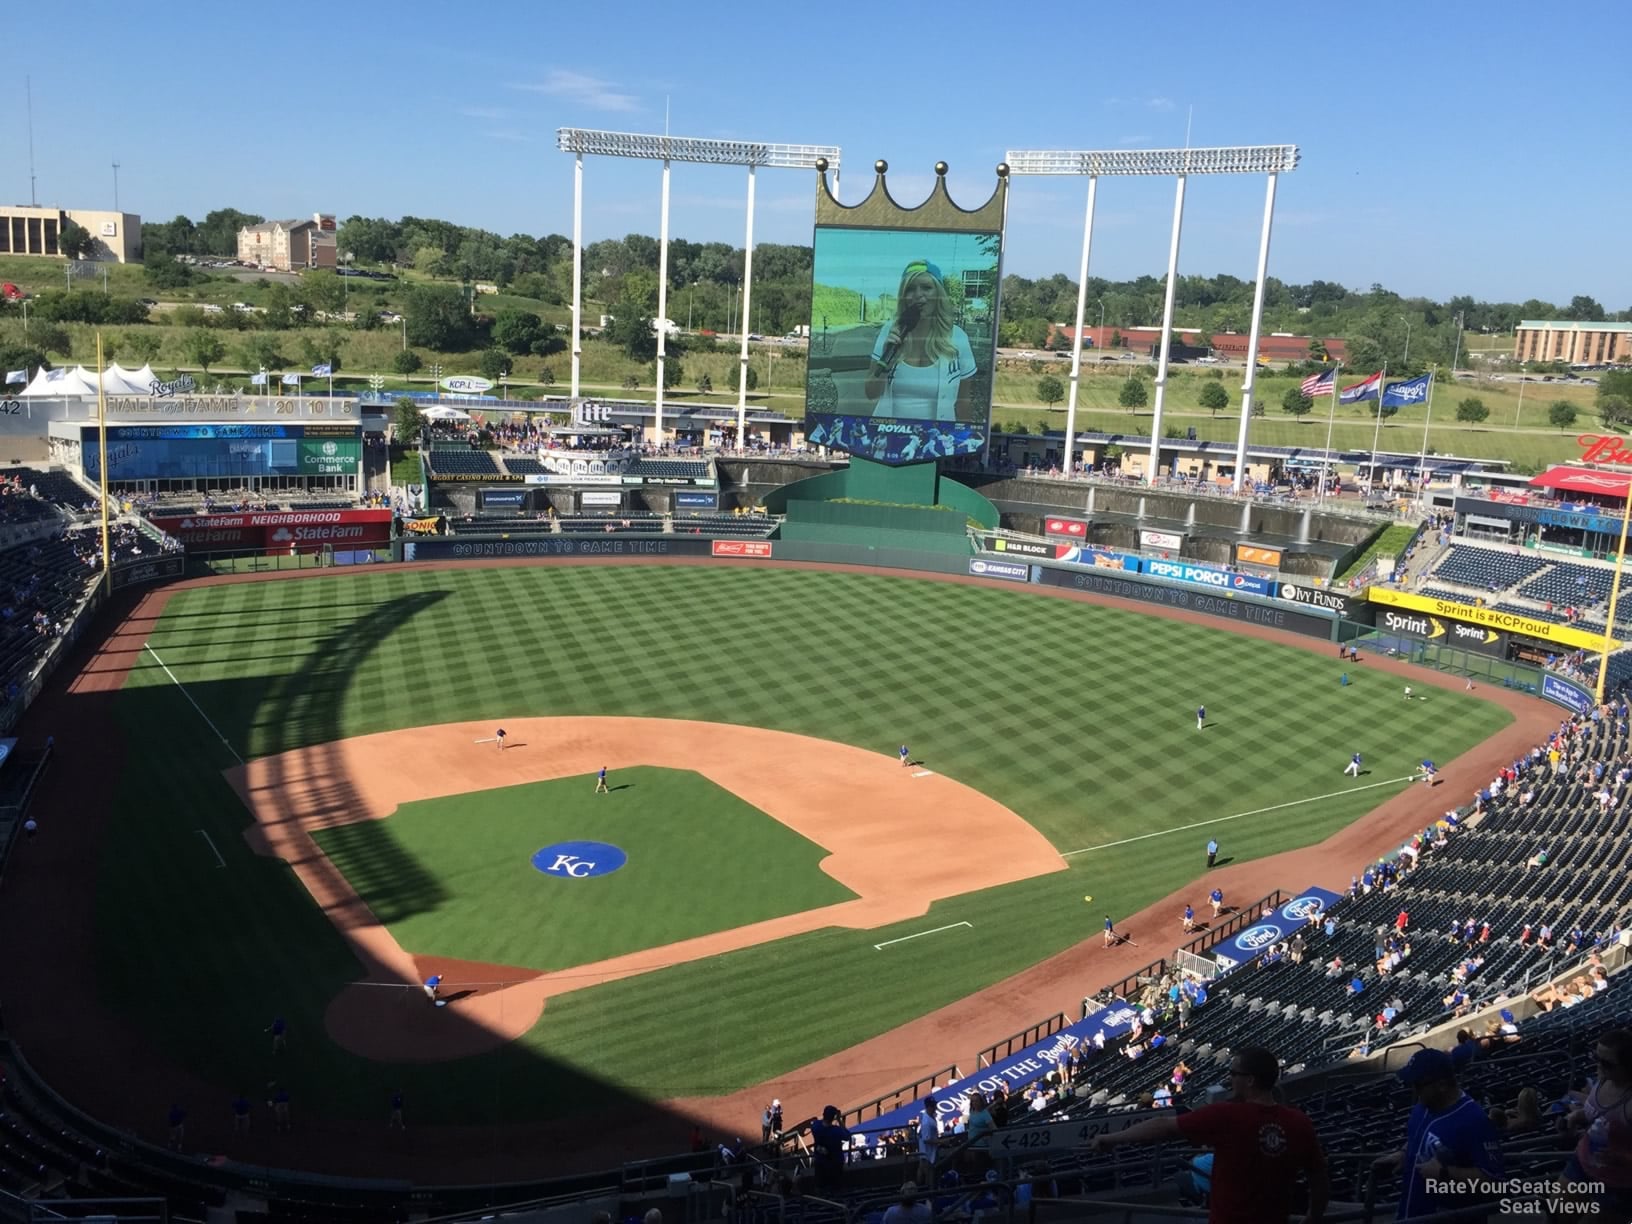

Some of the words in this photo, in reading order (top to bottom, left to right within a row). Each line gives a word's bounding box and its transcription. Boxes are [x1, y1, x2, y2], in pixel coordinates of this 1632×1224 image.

[149, 373, 196, 398] Royals
[0, 401, 20, 415] 42
[106, 397, 159, 413] HALL
[163, 400, 179, 416] of
[182, 397, 239, 413] FAME
[274, 400, 295, 414] 20
[307, 400, 325, 414] 10
[341, 400, 352, 414] 5
[576, 402, 613, 425] Lite
[877, 423, 913, 434] ROYAL
[304, 455, 355, 464] Commerce
[318, 463, 343, 473] Bank
[456, 473, 482, 481] CASINO
[482, 473, 504, 481] HOTEL
[251, 513, 341, 525] NEIGHBORHOOD
[1504, 505, 1588, 527] COUNTDOWN
[405, 521, 437, 530] SONIC
[453, 542, 549, 555] COUNTDOWN
[555, 541, 574, 553] TO
[580, 541, 623, 553] GAME
[629, 541, 668, 553] TIME
[1006, 543, 1022, 551] H&R
[1022, 545, 1048, 554] BLOCK
[987, 565, 1012, 574] KANSAS
[1011, 567, 1026, 576] CITY
[1150, 561, 1182, 577] PEPSI
[1185, 567, 1230, 586] PORCH
[1074, 574, 1165, 601] COUNTDOWN
[1170, 590, 1189, 606] TO
[1195, 596, 1239, 616] GAME
[1245, 606, 1286, 626] TIME
[1385, 612, 1428, 636] Sprint
[1436, 601, 1474, 620] Sprint
[1475, 611, 1486, 622] is
[1488, 614, 1551, 635] #KCProud
[1455, 624, 1485, 641] Sprint
[547, 854, 596, 878] KC
[1289, 902, 1317, 919] Ford
[1243, 928, 1275, 947] Ford
[978, 1074, 1004, 1092] OF
[1001, 1058, 1042, 1080] THE
[1037, 1033, 1079, 1065] Royals
[1019, 1130, 1051, 1149] 423
